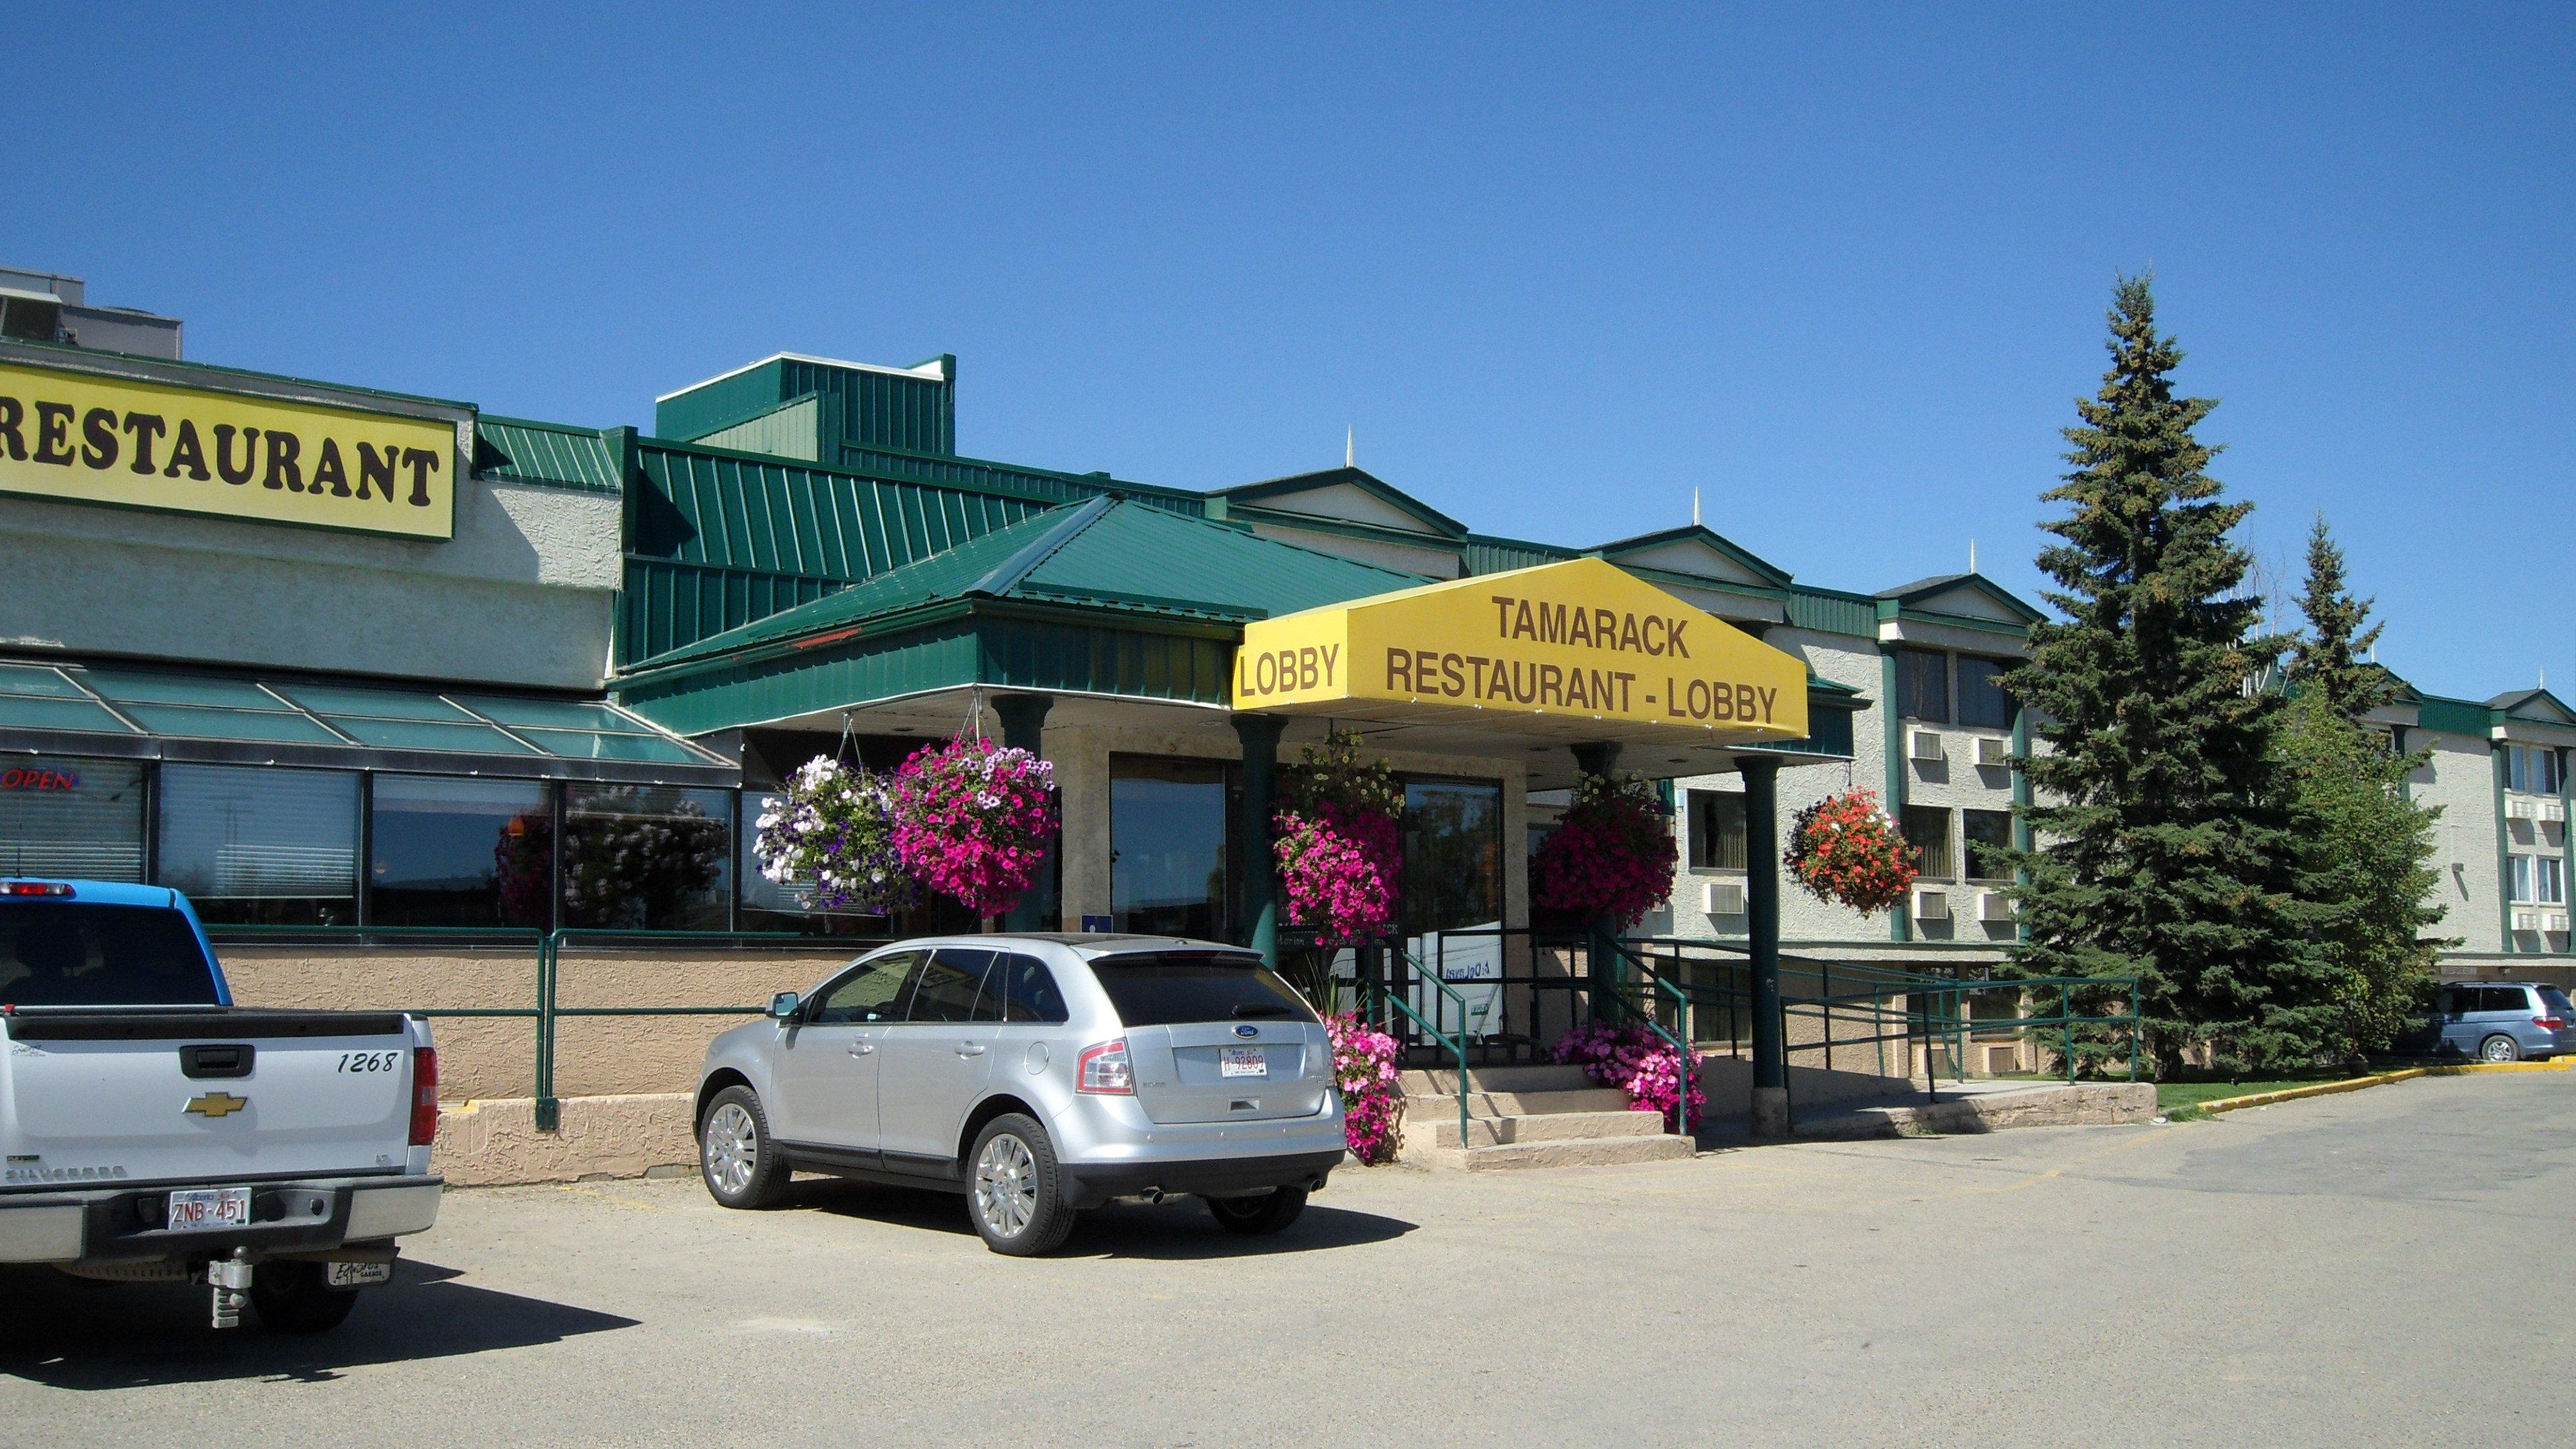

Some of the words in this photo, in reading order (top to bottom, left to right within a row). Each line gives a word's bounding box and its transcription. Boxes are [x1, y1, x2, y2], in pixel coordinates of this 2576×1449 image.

[0, 396, 439, 507] RESTAURANT
[1491, 596, 1690, 659] TAMARACK
[1240, 643, 1340, 698] LOBBY
[1387, 648, 1636, 713] RESTAURANT
[1668, 678, 1778, 724] LOBBY
[1, 768, 76, 791] OPEN
[337, 1052, 398, 1073] 1268
